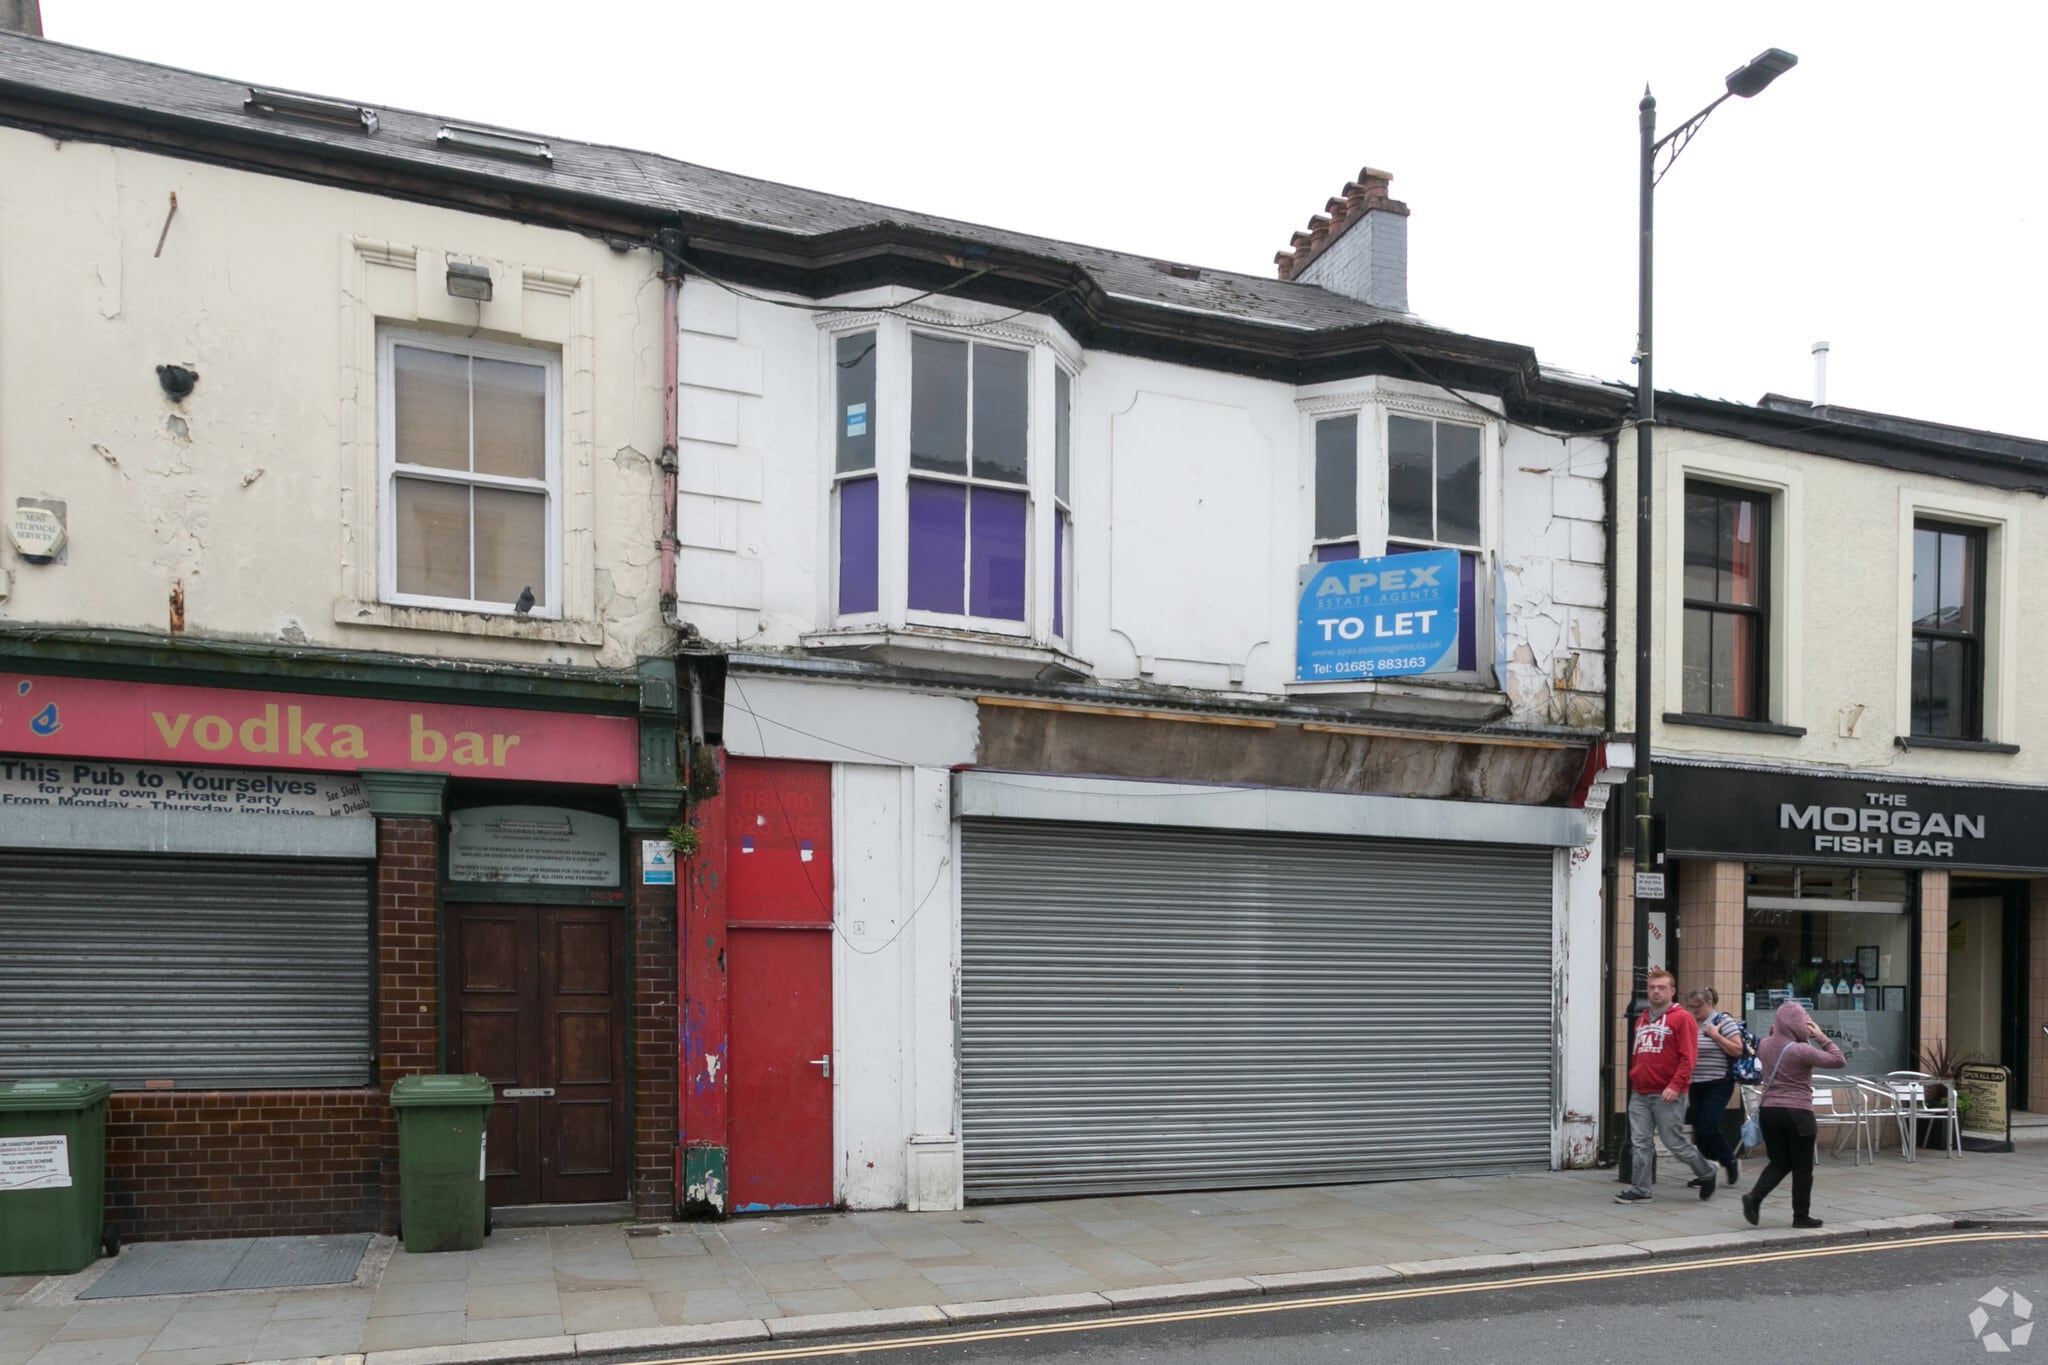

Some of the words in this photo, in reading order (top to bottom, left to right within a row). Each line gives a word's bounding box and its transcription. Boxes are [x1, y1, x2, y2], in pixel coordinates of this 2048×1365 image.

[16, 523, 56, 533] TECHNICAL
[25, 514, 46, 522] MOSS
[17, 531, 52, 541] SERVICES
[1316, 565, 1441, 597] APEX
[1318, 596, 1371, 608] ESTATE
[1380, 589, 1439, 603] AGENTS
[1317, 617, 1365, 641] TO
[1375, 610, 1438, 638] LET
[1313, 663, 1332, 674] Tel:
[1336, 660, 1374, 673] 01685
[1378, 657, 1426, 670] 883163
[151, 703, 369, 760] vodka
[409, 713, 520, 767] bar
[0, 761, 60, 782] This
[72, 765, 125, 788] Pub
[136, 770, 164, 789] to
[176, 770, 318, 796] Yourselves
[38, 782, 64, 794] for
[70, 785, 113, 798] your
[119, 788, 157, 800] own
[166, 789, 229, 803] Private
[236, 792, 282, 808] Party
[326, 790, 340, 802] See
[340, 783, 361, 800] Staff
[1864, 792, 1908, 808] THE
[2, 793, 50, 806] From
[58, 796, 129, 809] Monday
[149, 800, 233, 814] Thursday
[240, 804, 315, 815] inclusive
[1780, 802, 1986, 840] MORGAN
[1814, 834, 1883, 855] FISH
[1892, 838, 1954, 858] BAR
[1990, 1074, 2004, 1082] DAY
